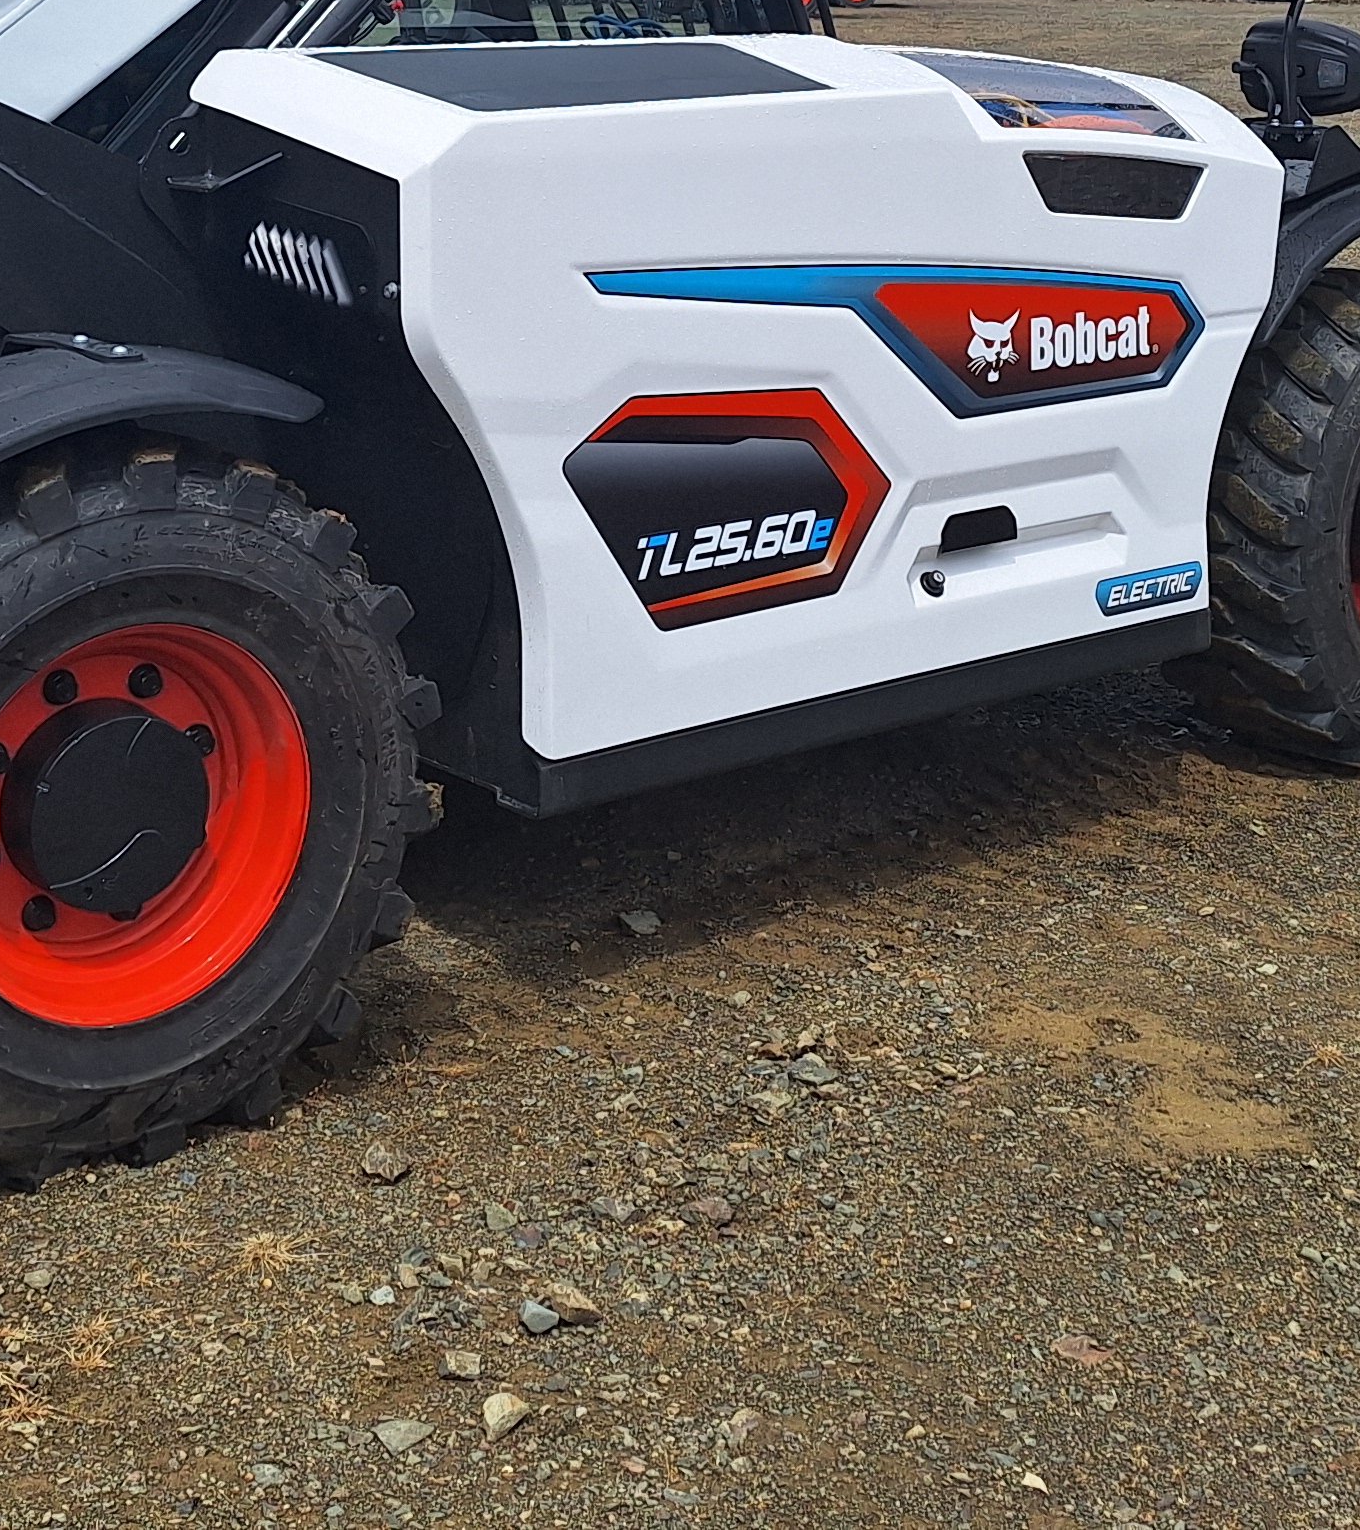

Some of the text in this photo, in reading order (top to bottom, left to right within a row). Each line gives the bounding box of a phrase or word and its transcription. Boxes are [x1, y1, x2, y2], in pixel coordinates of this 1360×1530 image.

[1030, 305, 1151, 371] Bobcat
[637, 509, 835, 581] TL25.60e
[1106, 570, 1196, 608] ELECTRIC
